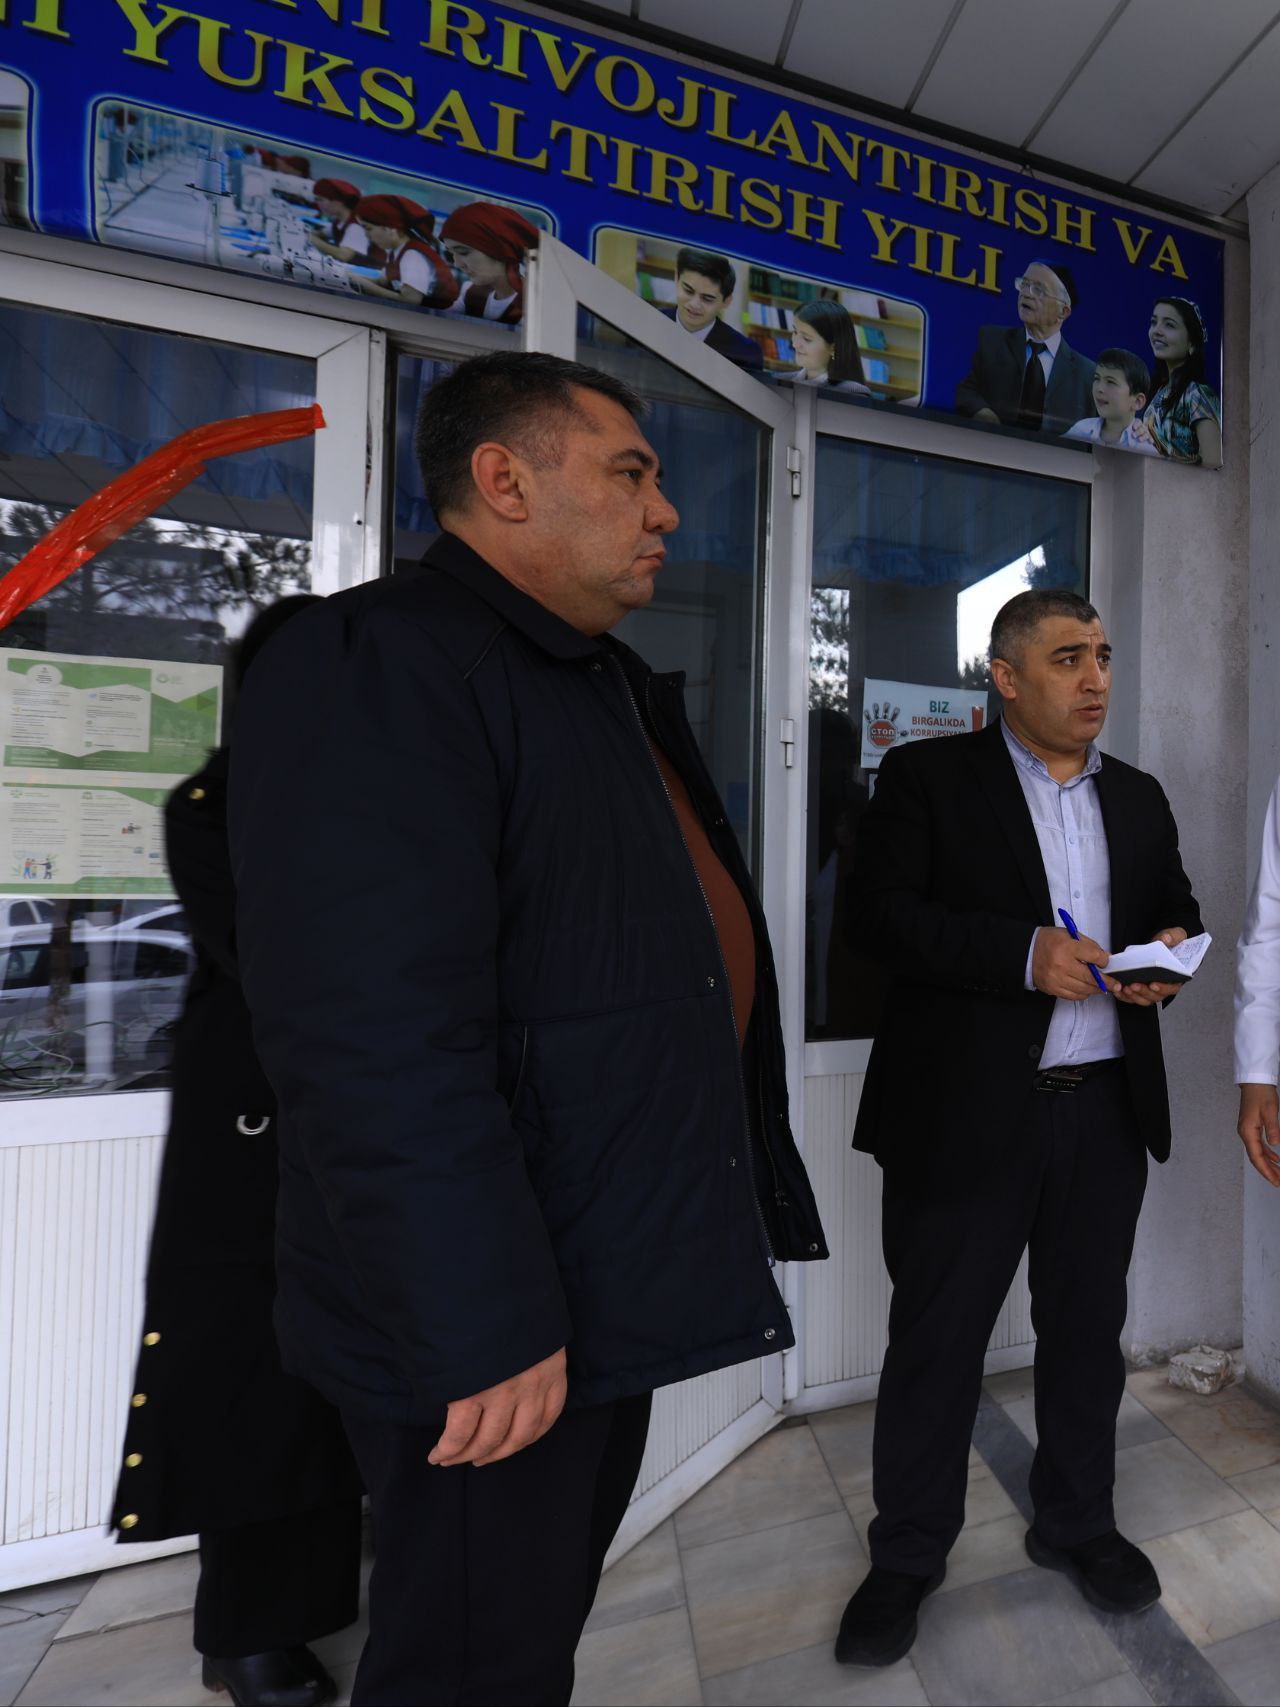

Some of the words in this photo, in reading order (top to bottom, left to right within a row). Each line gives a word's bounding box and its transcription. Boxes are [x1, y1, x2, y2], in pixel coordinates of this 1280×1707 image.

[116, 0, 844, 250] YUKSALTIRISH
[862, 207, 1003, 294] YILI
[420, 0, 1097, 253] RIVOJLANTIRISH
[1112, 215, 1189, 280] VA
[912, 716, 966, 728] BIRGALIKDA
[929, 700, 949, 714] BIZ
